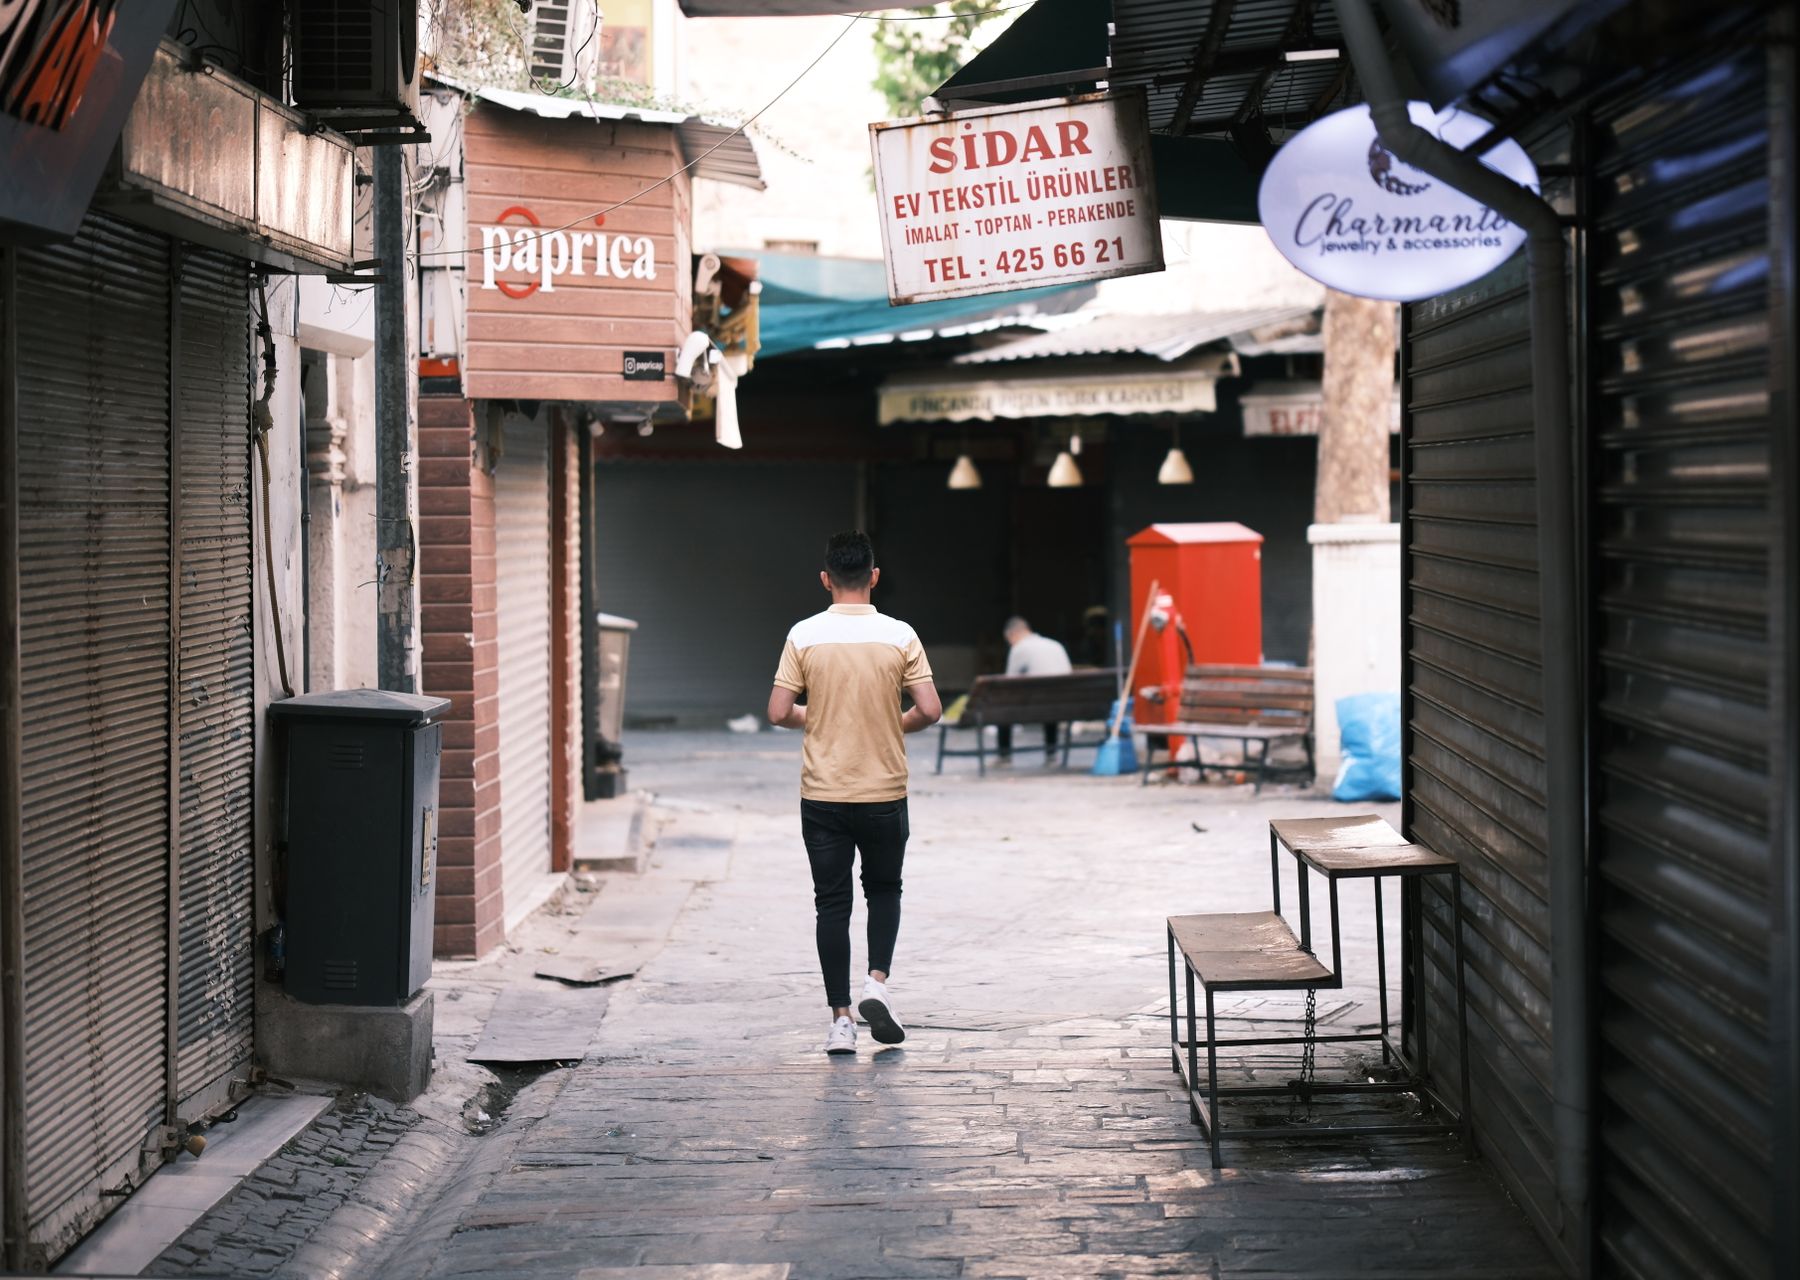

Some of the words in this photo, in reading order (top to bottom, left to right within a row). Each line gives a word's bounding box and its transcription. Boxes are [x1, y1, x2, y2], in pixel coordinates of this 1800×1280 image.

[929, 120, 1092, 174] SİDAR
[893, 192, 920, 219] EV
[928, 176, 1020, 214] TEKSTİL
[905, 223, 960, 246] İMALAT
[975, 213, 1032, 236] TOPTAN
[1048, 200, 1136, 227] PERAKENDE
[1320, 234, 1381, 255] jewelry
[1387, 238, 1397, 250] &
[1403, 234, 1502, 250] accessories
[480, 212, 657, 292] paprica
[924, 255, 971, 283] TEL
[996, 246, 1044, 274] 425
[1053, 241, 1086, 268] 66
[1094, 236, 1124, 263] 21
